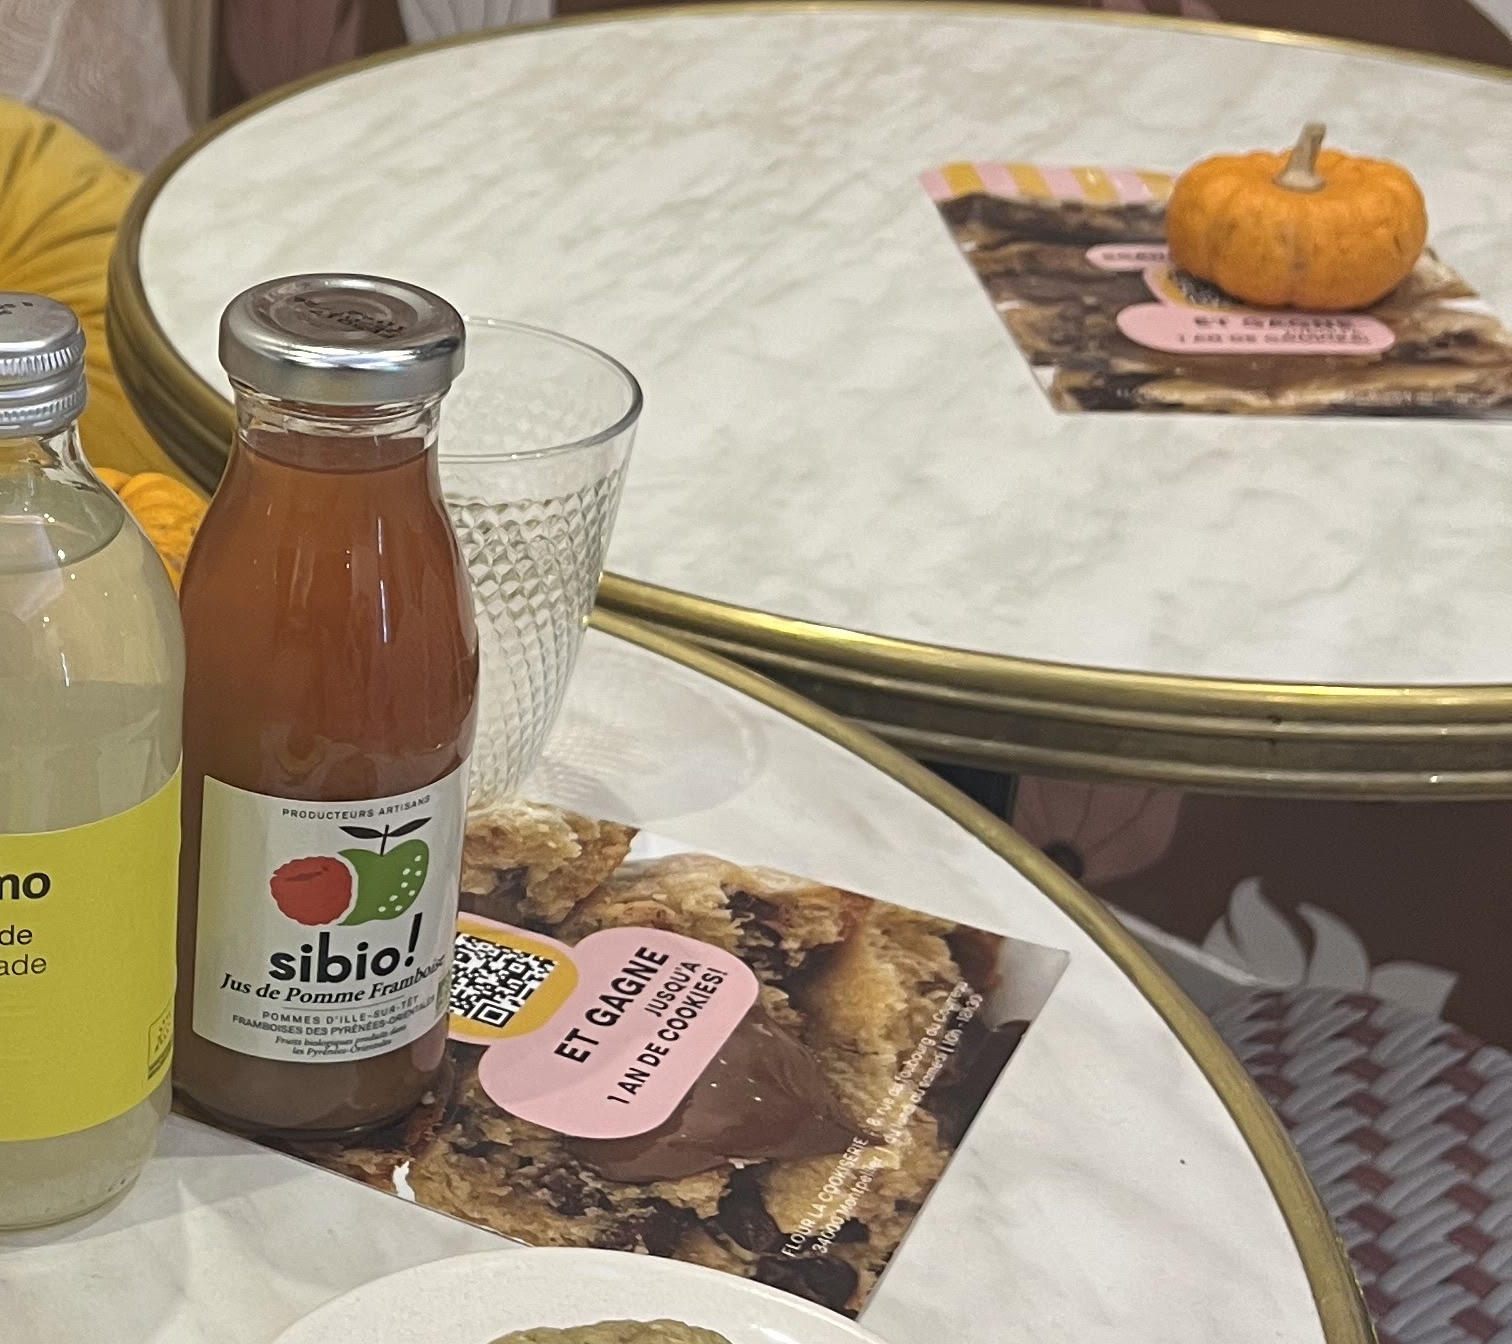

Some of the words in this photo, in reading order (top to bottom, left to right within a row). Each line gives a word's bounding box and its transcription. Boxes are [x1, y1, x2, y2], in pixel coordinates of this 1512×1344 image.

[282, 808, 374, 820] PRODUCTEURS
[378, 795, 431, 816] ARTISANS
[268, 912, 423, 984] sibio!
[220, 973, 252, 994] Jus
[256, 982, 281, 1000] de
[282, 987, 365, 1004] Pomme
[644, 961, 701, 1017] JUSQU'A
[262, 1011, 321, 1025] POMMES
[554, 1027, 600, 1064] ET
[585, 946, 670, 1027] GAGNE
[657, 967, 729, 1042] COOKIES!
[232, 1014, 303, 1035] FRAMBOISES
[305, 1024, 329, 1036] DES
[637, 1042, 670, 1067] DE
[617, 1067, 651, 1095] AN
[606, 1095, 630, 1105] 1
[817, 1136, 869, 1203] COOKISERIE
[811, 1203, 827, 1218] LA
[781, 1217, 816, 1257] FLOUR
[811, 1215, 845, 1254] 34000
